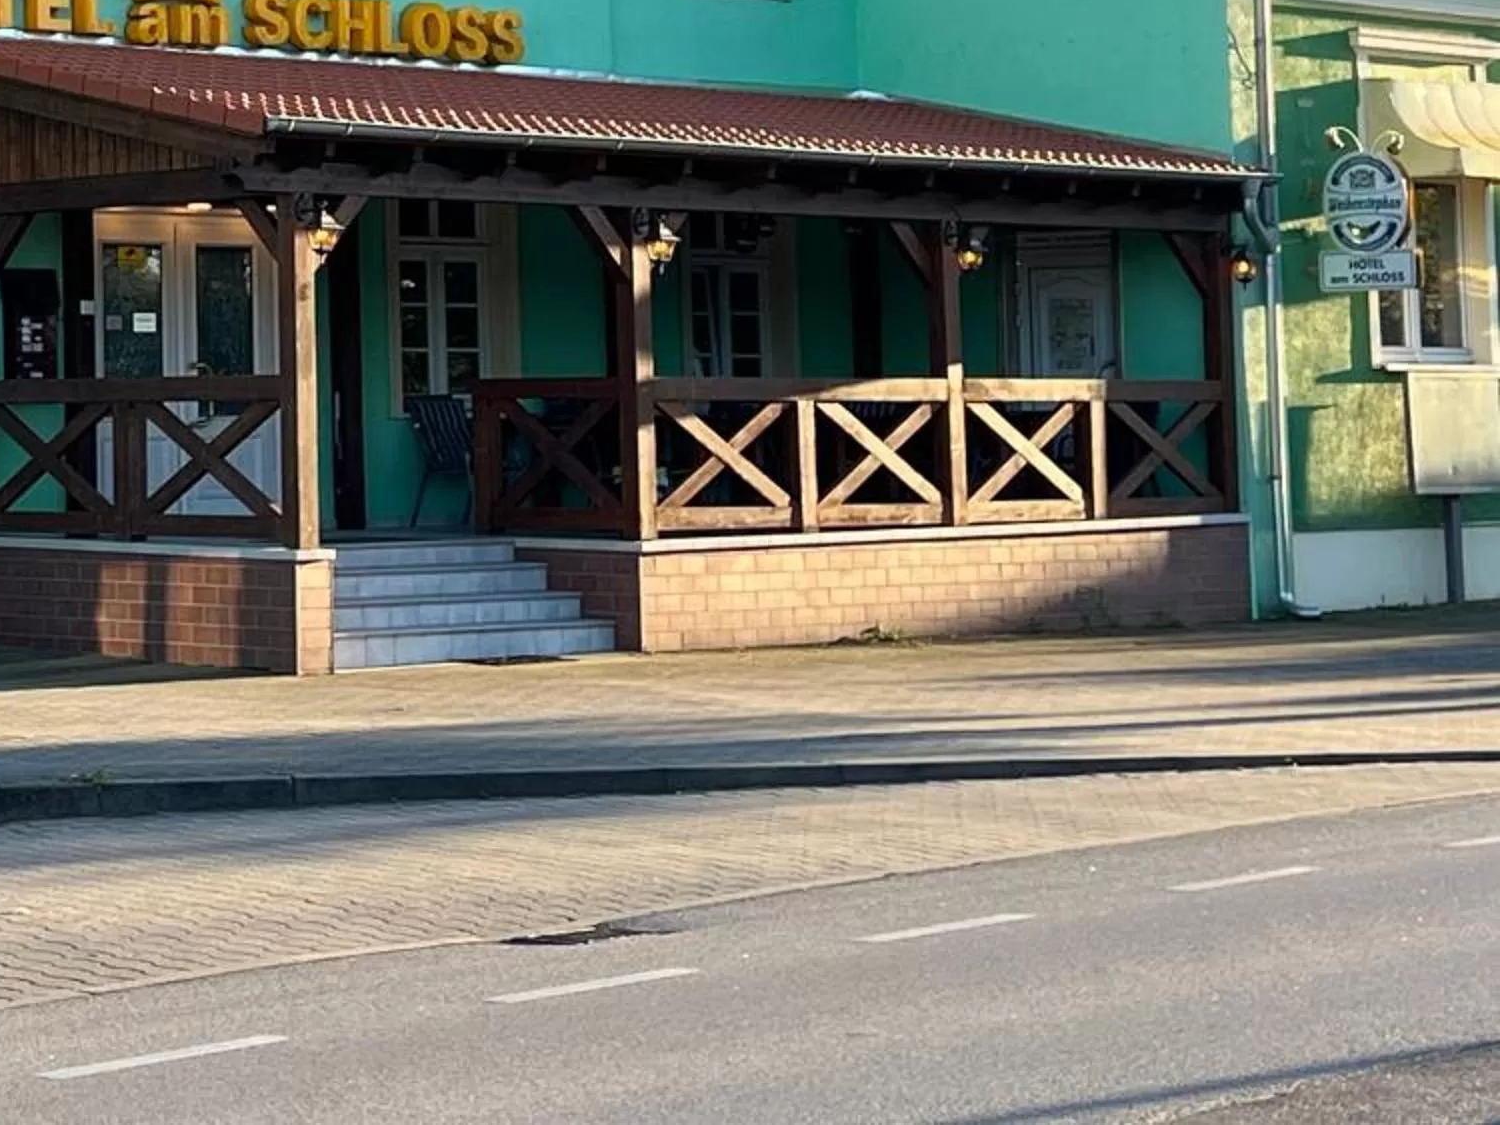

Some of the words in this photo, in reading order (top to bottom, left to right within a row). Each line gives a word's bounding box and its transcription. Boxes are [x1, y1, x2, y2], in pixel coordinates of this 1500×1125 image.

[125, 2, 229, 47] am
[1348, 258, 1386, 270] HOTEL
[1352, 271, 1405, 284] SCHLOSS
